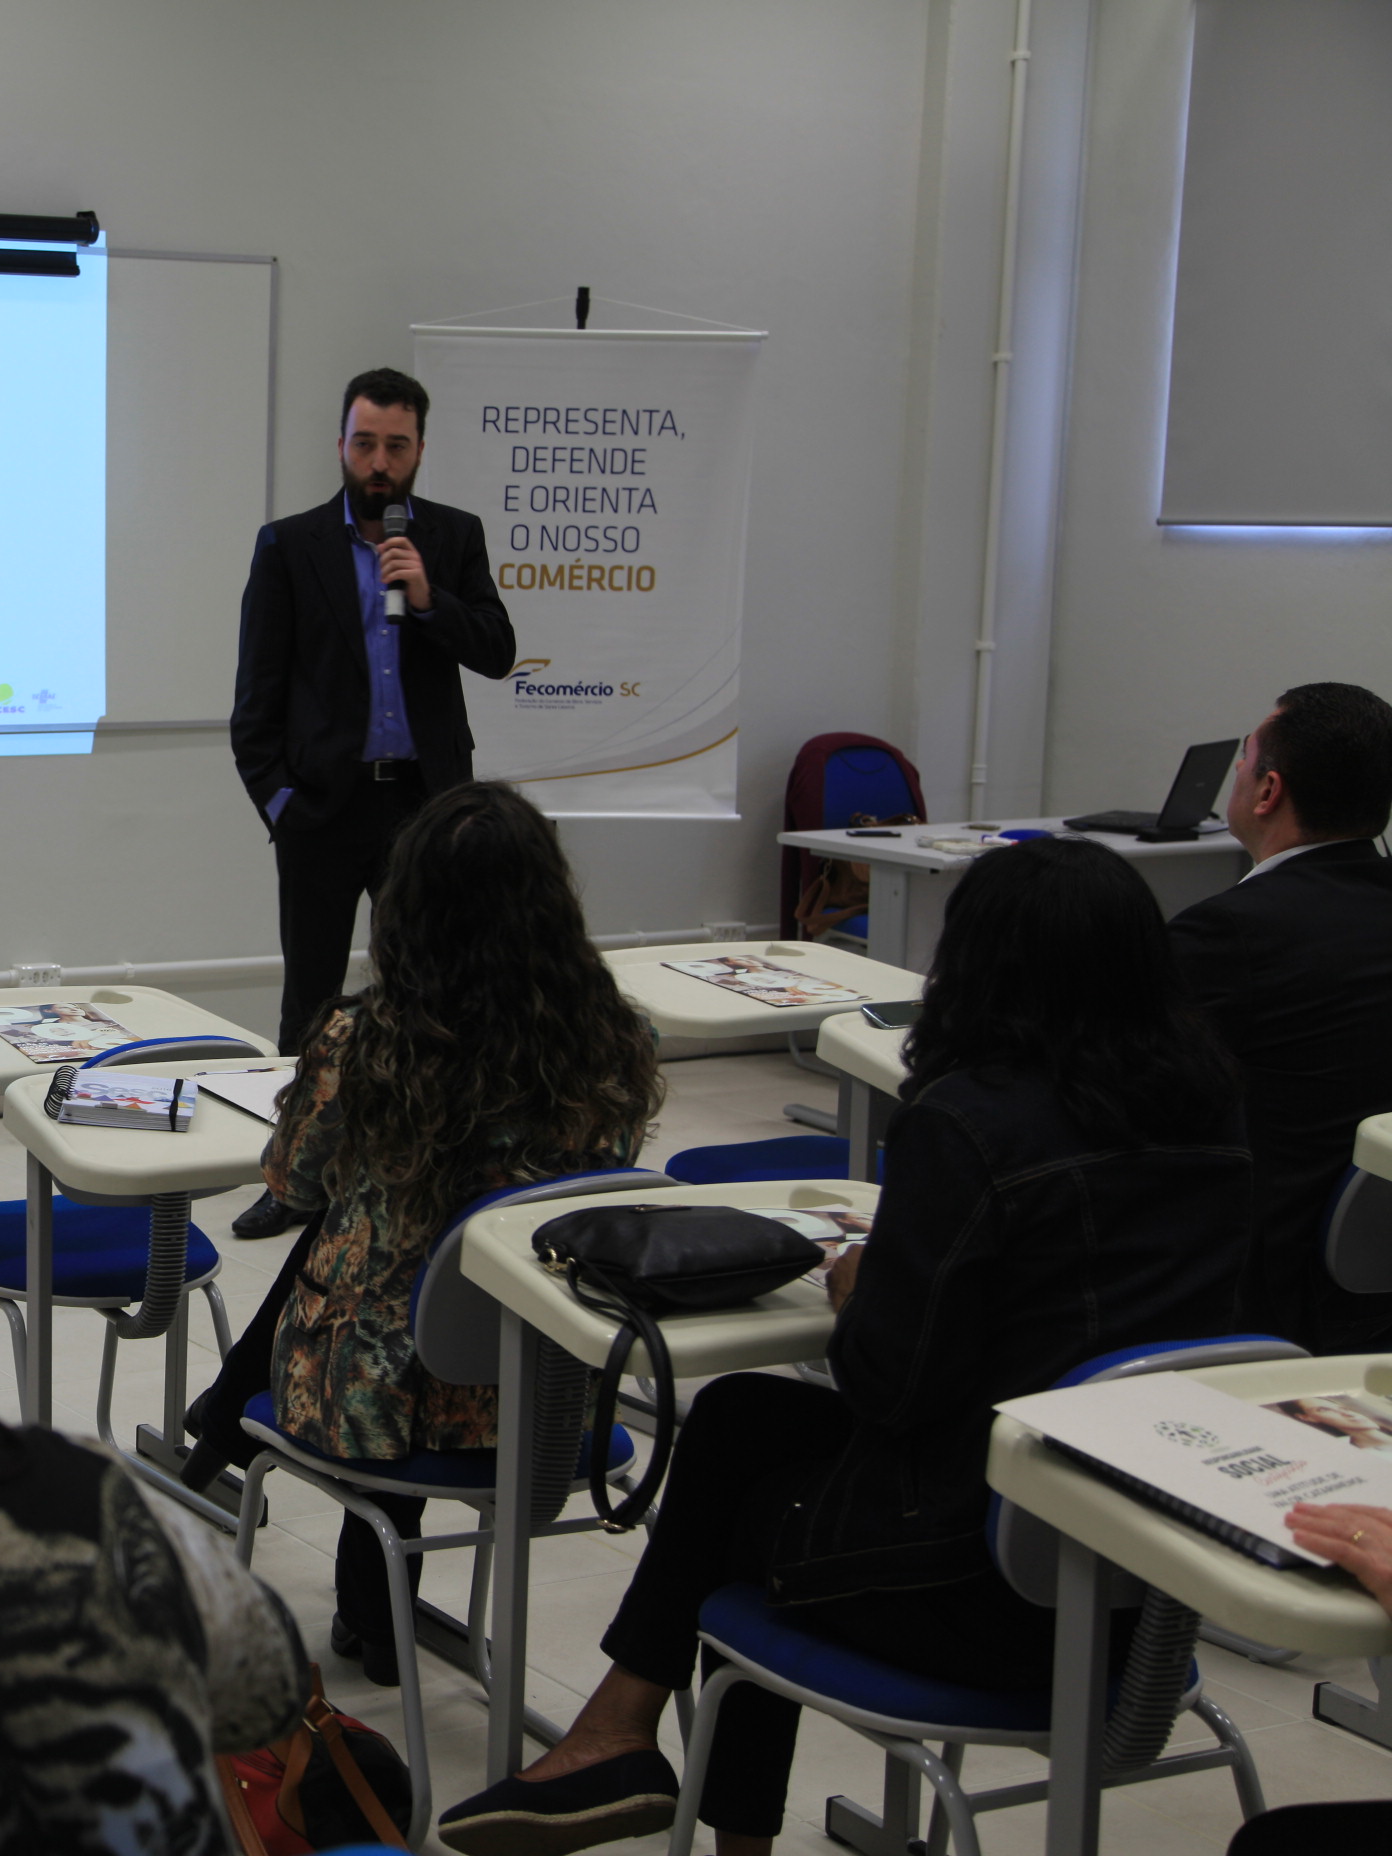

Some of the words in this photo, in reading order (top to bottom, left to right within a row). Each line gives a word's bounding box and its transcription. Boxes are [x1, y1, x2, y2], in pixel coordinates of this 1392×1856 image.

[482, 405, 686, 440] REPRESENTA,
[511, 445, 647, 476] DEFENDE
[504, 485, 520, 513] E
[530, 485, 657, 515] ORIENTA
[510, 523, 530, 551] O
[540, 524, 641, 553] NOSSO
[498, 558, 656, 592] COMÉRCIO
[515, 681, 614, 696] Fecomércio
[620, 682, 641, 697] SC
[1217, 1454, 1291, 1479] SOCIAL
